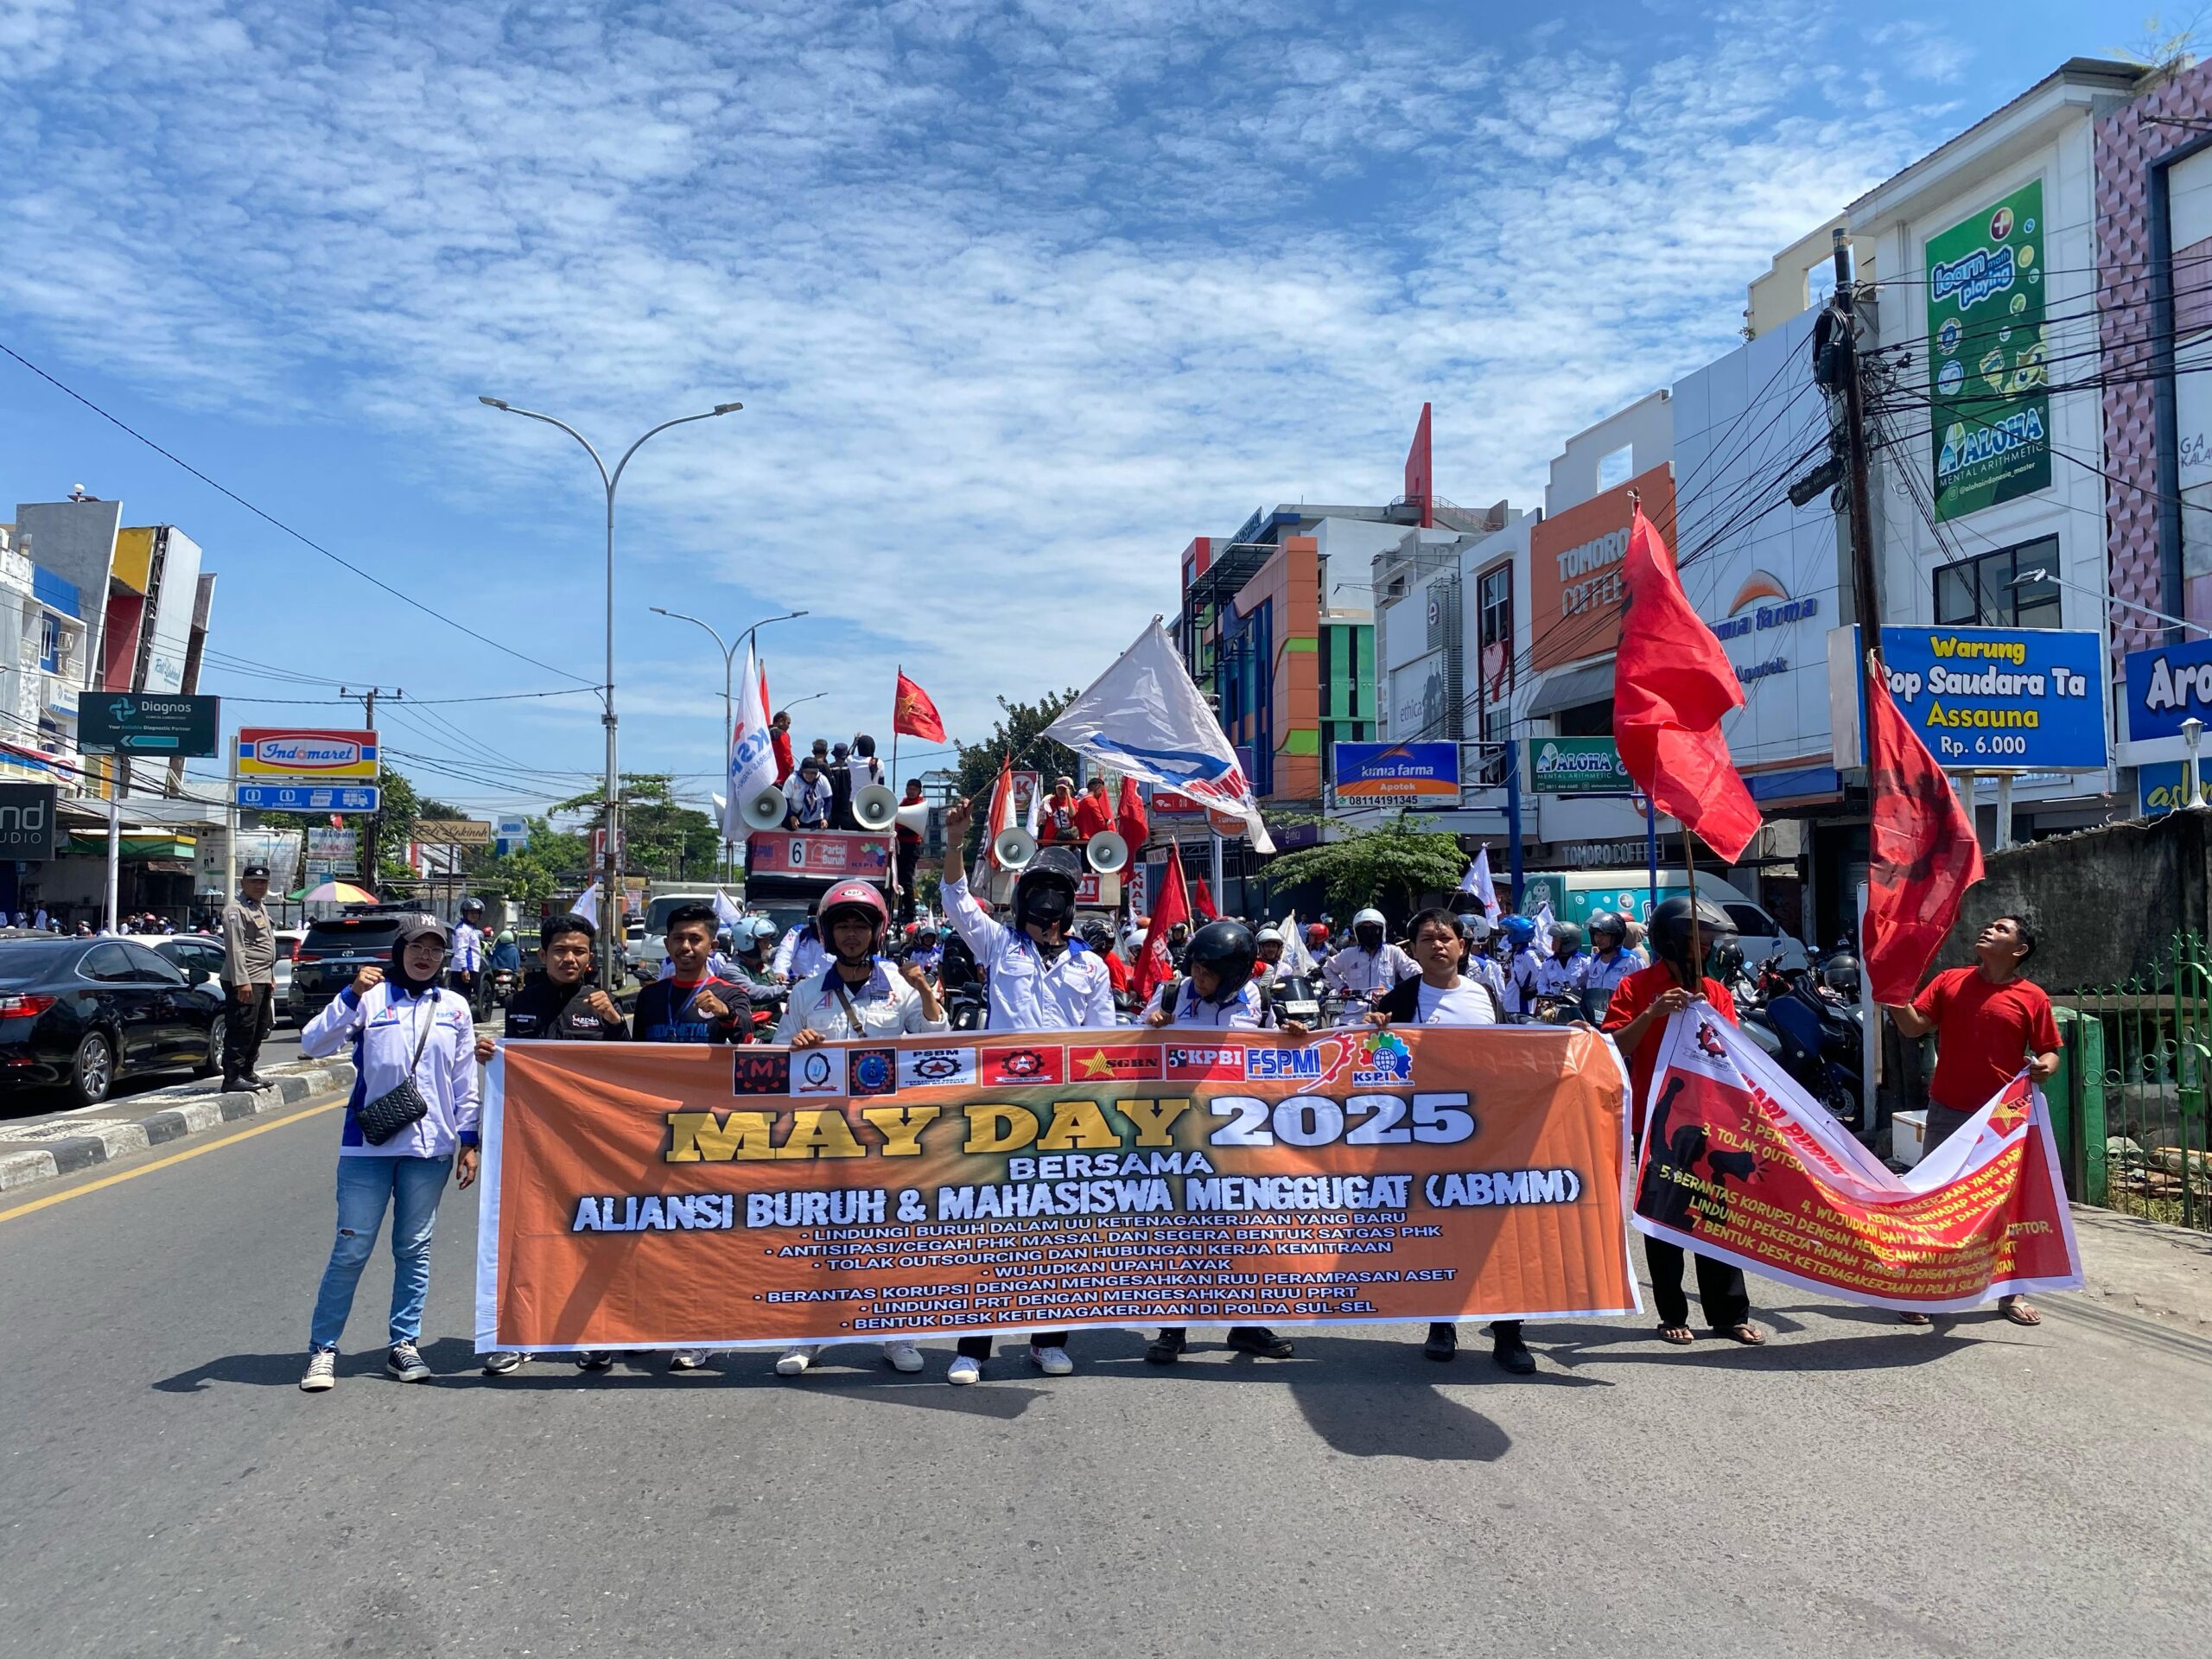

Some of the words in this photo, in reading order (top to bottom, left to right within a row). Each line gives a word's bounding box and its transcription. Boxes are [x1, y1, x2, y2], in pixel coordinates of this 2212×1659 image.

[1987, 251, 2010, 269] math
[1936, 254, 1986, 295] learn
[1963, 265, 2011, 304] playing
[1961, 407, 2044, 467] ALOHA
[1940, 467, 1978, 487] MENTAL
[1980, 442, 2044, 474] ARITHMETIC
[1556, 526, 1632, 582] TOMORO
[1756, 597, 1817, 631] farma
[1929, 635, 2026, 665] Warung
[1927, 664, 2045, 696] Saudara
[2050, 666, 2087, 696] Ta
[141, 701, 192, 715] Diagnos
[1400, 698, 1423, 722] ethica
[1925, 700, 2039, 728] Assauna
[262, 743, 353, 760] Indomaret
[1941, 735, 1969, 758] Rp.
[1974, 735, 2026, 754] 6.000
[1361, 765, 1395, 777] kimia
[1398, 764, 1434, 776] farma
[1556, 753, 1612, 772] ALOHA
[1016, 780, 1030, 796] K
[1349, 795, 1418, 805] 08114191345
[1380, 783, 1416, 792] Apotek
[791, 842, 803, 864] 6
[822, 855, 845, 865] Buruh
[823, 844, 846, 855] Partai
[1561, 844, 1611, 865] TOMORO
[912, 1049, 959, 1058] PSBM
[1187, 1049, 1243, 1065] KPBI
[1247, 1048, 1321, 1074] FSPMI
[749, 1059, 774, 1078] M
[1353, 1071, 1389, 1082] KSPI
[665, 1105, 941, 1162] MAY
[963, 1098, 1192, 1154] DAY
[1210, 1092, 1475, 1146] 2025
[1701, 1122, 1712, 1137] 3.
[1717, 1127, 1761, 1154] TOLAK
[1739, 1118, 1751, 1133] 2.
[1008, 1151, 1214, 1180] BERSAMA
[1967, 1166, 1999, 1188] YANG
[572, 1193, 734, 1231] ALIANSI
[747, 1188, 887, 1229] BURUH
[896, 1188, 927, 1223] &
[938, 1176, 1173, 1221] MAHASISWA
[1185, 1174, 1412, 1211] MENGGUGAT
[1425, 1169, 1581, 1206] (ABMM)
[1908, 1198, 1968, 1224] TERHADAP
[1968, 1185, 1998, 1203] PHK
[814, 1227, 909, 1241] LINDUNGI
[916, 1224, 985, 1237] BURUH
[990, 1220, 1058, 1233] DALAM
[1065, 1218, 1091, 1230] UU
[1097, 1214, 1294, 1229] KETENAGAKERJAAN
[1296, 1214, 1348, 1225] YANG
[1354, 1212, 1407, 1224] BARU
[1659, 1164, 1671, 1180] 5.
[1673, 1168, 1740, 1205] BERANTAS
[1739, 1195, 1796, 1227] KORUPSI
[1796, 1217, 1852, 1247] DENGAN
[1851, 1236, 1936, 1264] MENGESAHKAN
[1800, 1199, 1812, 1214] 4.
[1815, 1205, 1878, 1238] WUJUDKAN
[1955, 1205, 1982, 1224] DAN
[779, 1238, 971, 1257] ANTISIPASI/CEGAH
[977, 1236, 1016, 1249] PHK
[1022, 1233, 1103, 1247] MASSAL
[1109, 1231, 1148, 1243] DAN
[1154, 1230, 1230, 1241] SEGERA
[1236, 1229, 1313, 1240] BENTUK
[1318, 1227, 1395, 1239] SATGAS
[1402, 1225, 1443, 1237] PHK
[1688, 1194, 1752, 1229] LINDUNGI
[1751, 1220, 1812, 1251] PEKERJA
[1814, 1242, 1859, 1268] RUMAH
[827, 1257, 894, 1270] TOLAK
[899, 1251, 1042, 1268] OUTSOURCING
[1048, 1248, 1089, 1261] DAN
[1094, 1244, 1203, 1257] HUBUNGAN
[1208, 1244, 1272, 1255] KERJA
[1276, 1242, 1392, 1254] KEMITRAAN
[1691, 1214, 1702, 1230] 7.
[1703, 1220, 1757, 1249] BENTUK
[1757, 1241, 1792, 1263] DESK
[1793, 1254, 1915, 1294] KETENAGAKERJAAN
[1926, 1282, 1956, 1294] POLDA
[995, 1262, 1105, 1278] WUJUDKAN
[1110, 1260, 1164, 1272] UPAH
[1168, 1259, 1232, 1270] LAYAK
[767, 1288, 877, 1303] BERANTAS
[882, 1284, 969, 1298] KORUPSI
[976, 1279, 1057, 1294] DENGAN
[1062, 1274, 1212, 1288] MENGESAHKAN
[1217, 1274, 1258, 1285] RUU
[1263, 1271, 1400, 1284] PERAMPASAN
[1405, 1269, 1457, 1281] ASET
[873, 1300, 968, 1314] LINDUNGI
[974, 1296, 1013, 1309] PRT
[1018, 1292, 1098, 1306] DENGAN
[1103, 1288, 1255, 1302] MENGESAHKAN
[1260, 1288, 1300, 1299] RUU
[1307, 1287, 1358, 1298] PPRT
[854, 1316, 938, 1330] BENTUK
[941, 1313, 993, 1325] DESK
[998, 1304, 1195, 1323] KETENAGAKERJAAN
[1199, 1304, 1217, 1315] DI
[1224, 1302, 1289, 1314] POLDA
[1294, 1300, 1378, 1313] SUL-SEL
